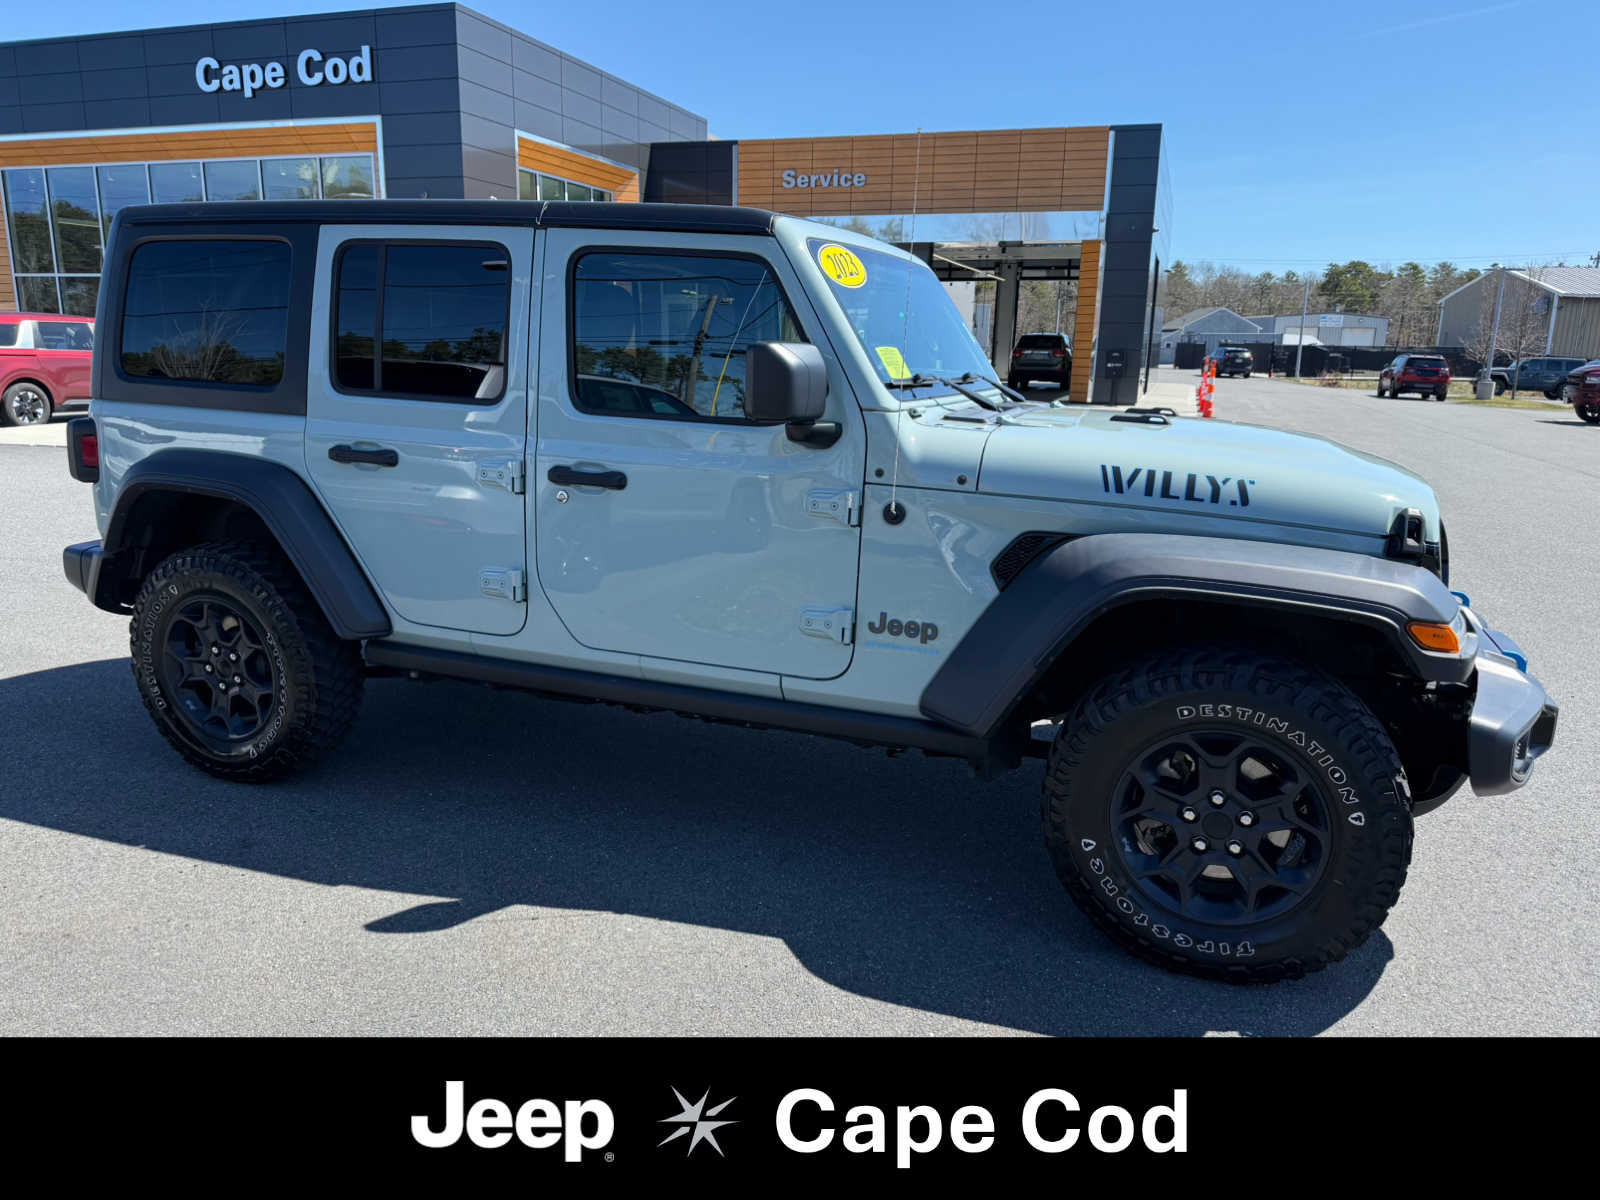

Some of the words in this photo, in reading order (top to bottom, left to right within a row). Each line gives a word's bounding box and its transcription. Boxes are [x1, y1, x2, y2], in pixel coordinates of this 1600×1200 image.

[195, 56, 286, 99] Cape
[296, 45, 373, 87] Cod
[781, 168, 867, 189] Service
[826, 252, 860, 280] 2023
[1100, 463, 1256, 507] WILLYS
[867, 610, 939, 645] Jeep
[1176, 703, 1360, 805] DESTINATION
